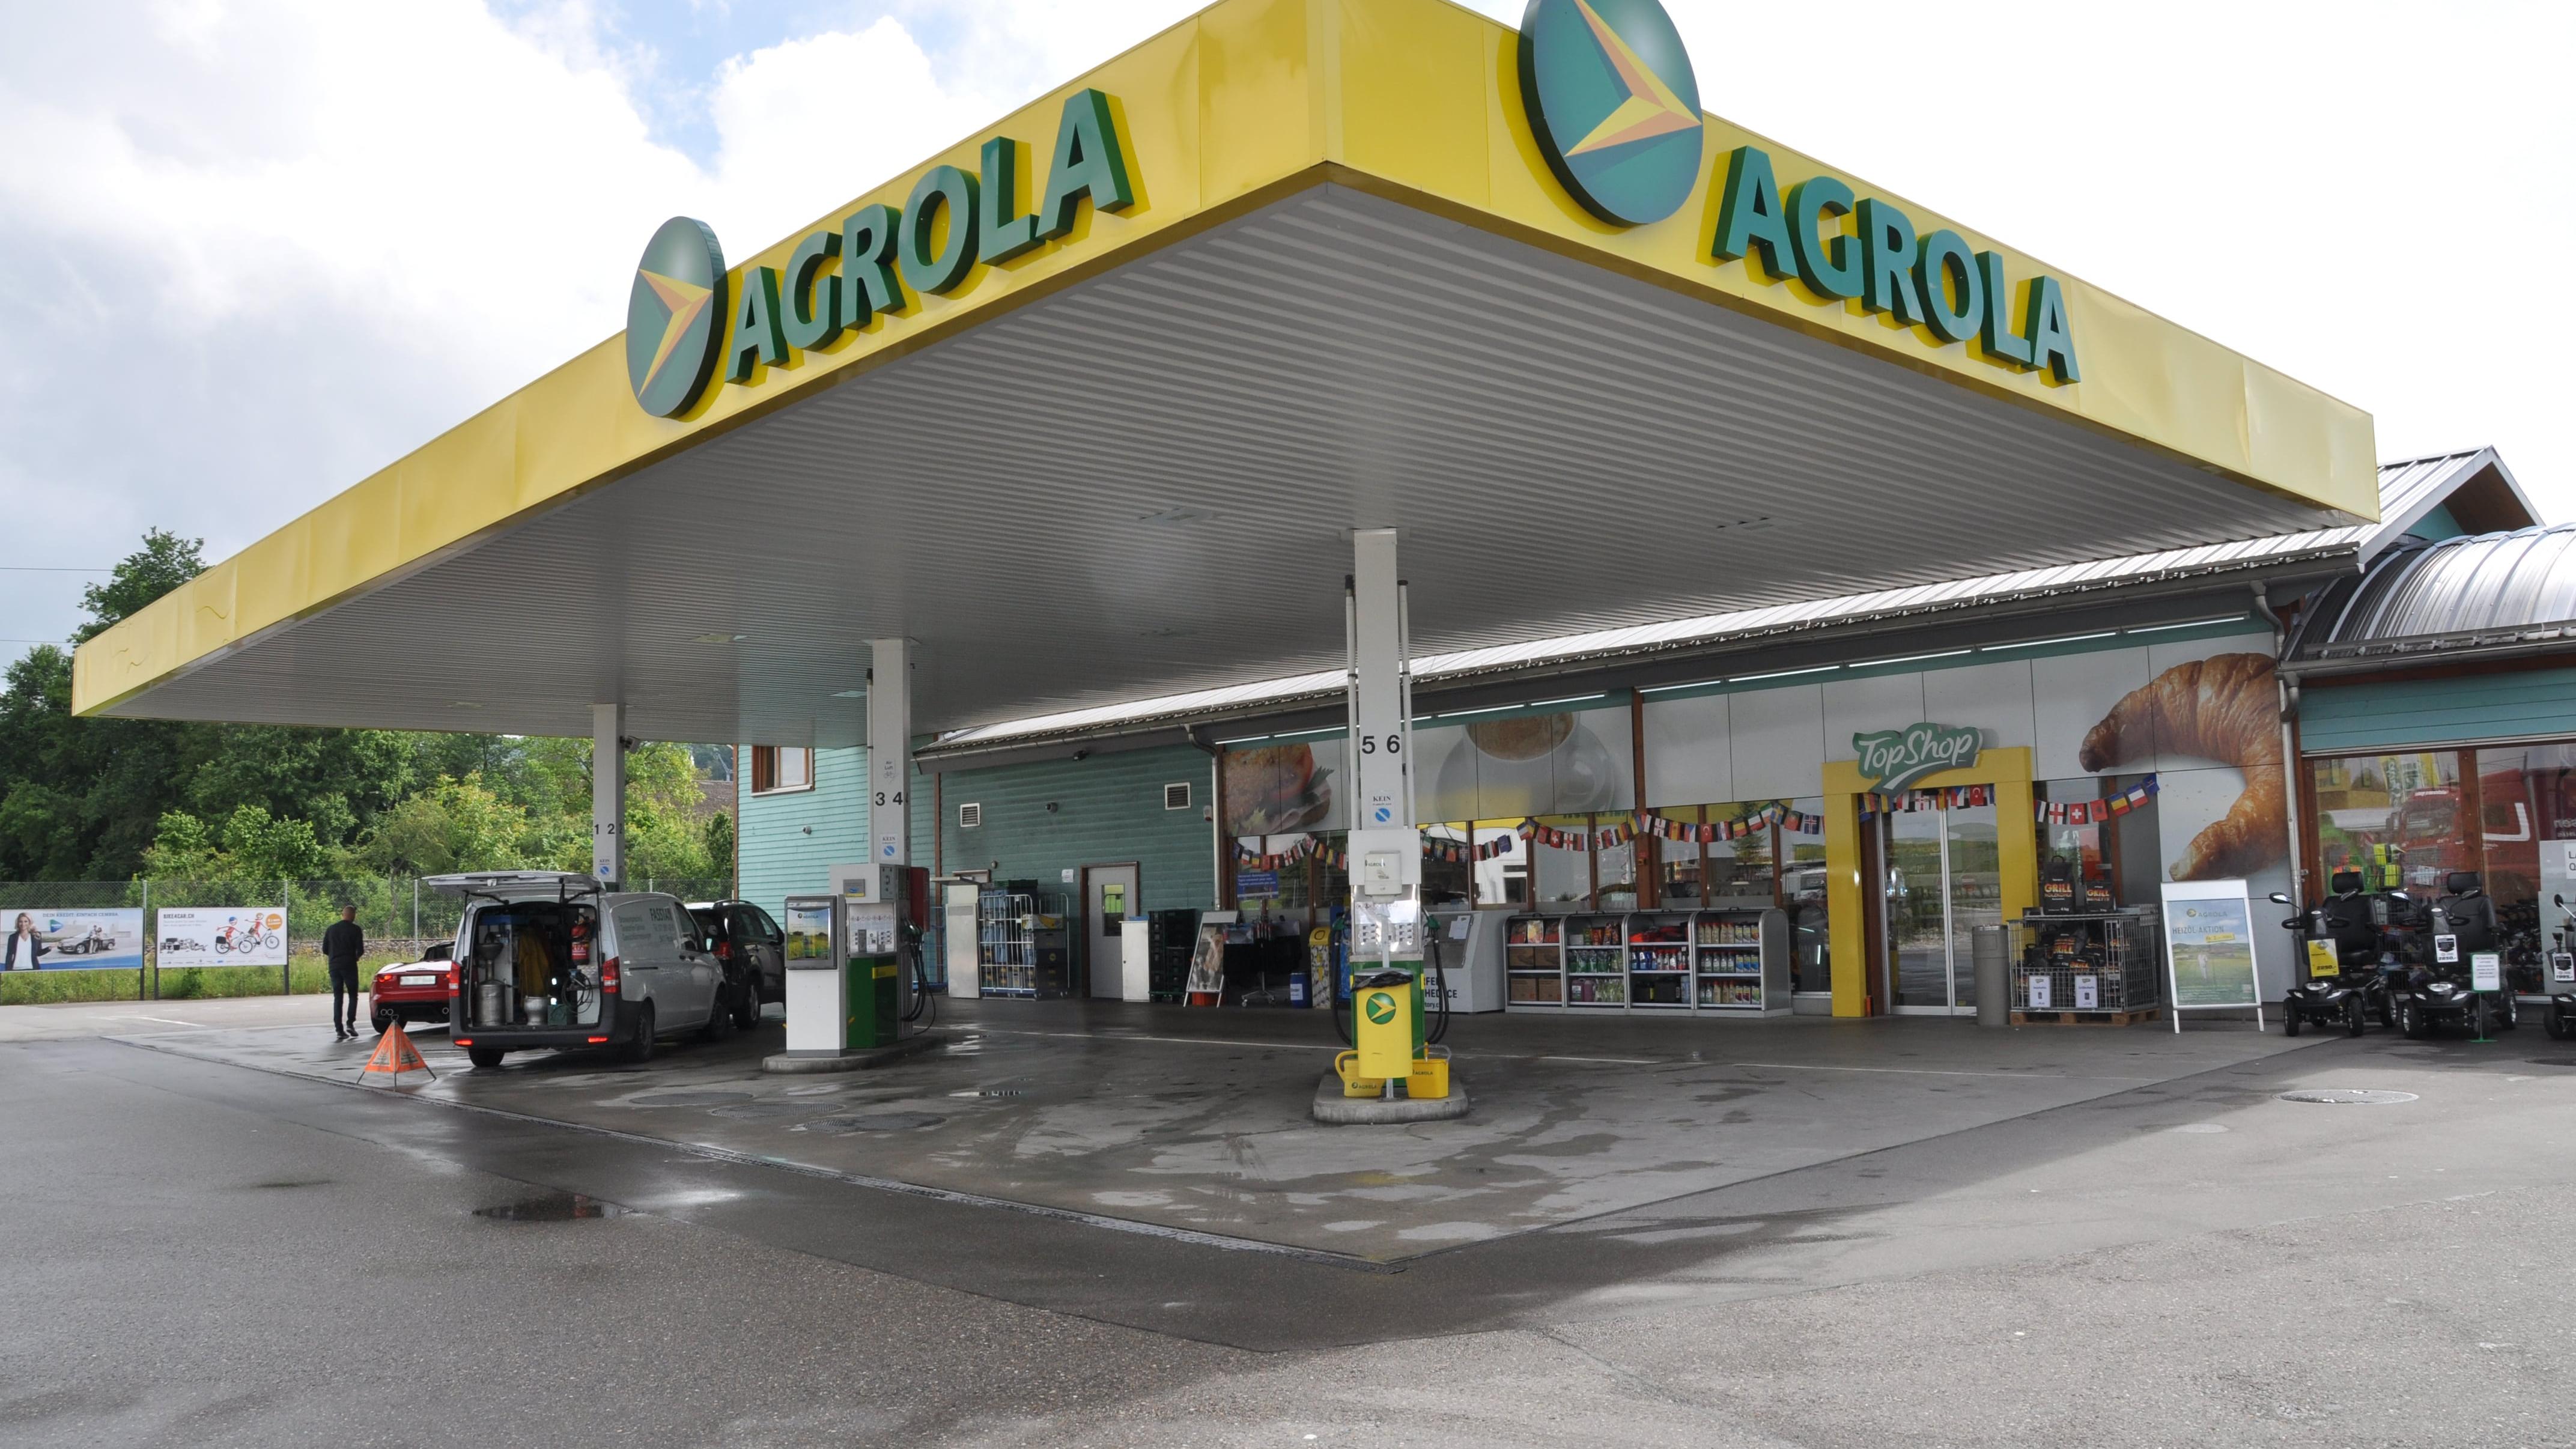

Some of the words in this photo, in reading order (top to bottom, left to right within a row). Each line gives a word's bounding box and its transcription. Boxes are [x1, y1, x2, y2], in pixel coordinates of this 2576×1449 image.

[724, 88, 1134, 384] AGROLA
[1711, 145, 2080, 384] AGROLA
[1362, 735, 1376, 755] 5
[1387, 735, 1400, 753] 6
[875, 792, 886, 806] 3
[893, 792, 903, 806] 4
[594, 824, 600, 835] 1
[607, 823, 615, 834] 2
[2045, 883, 2072, 893] GRILL
